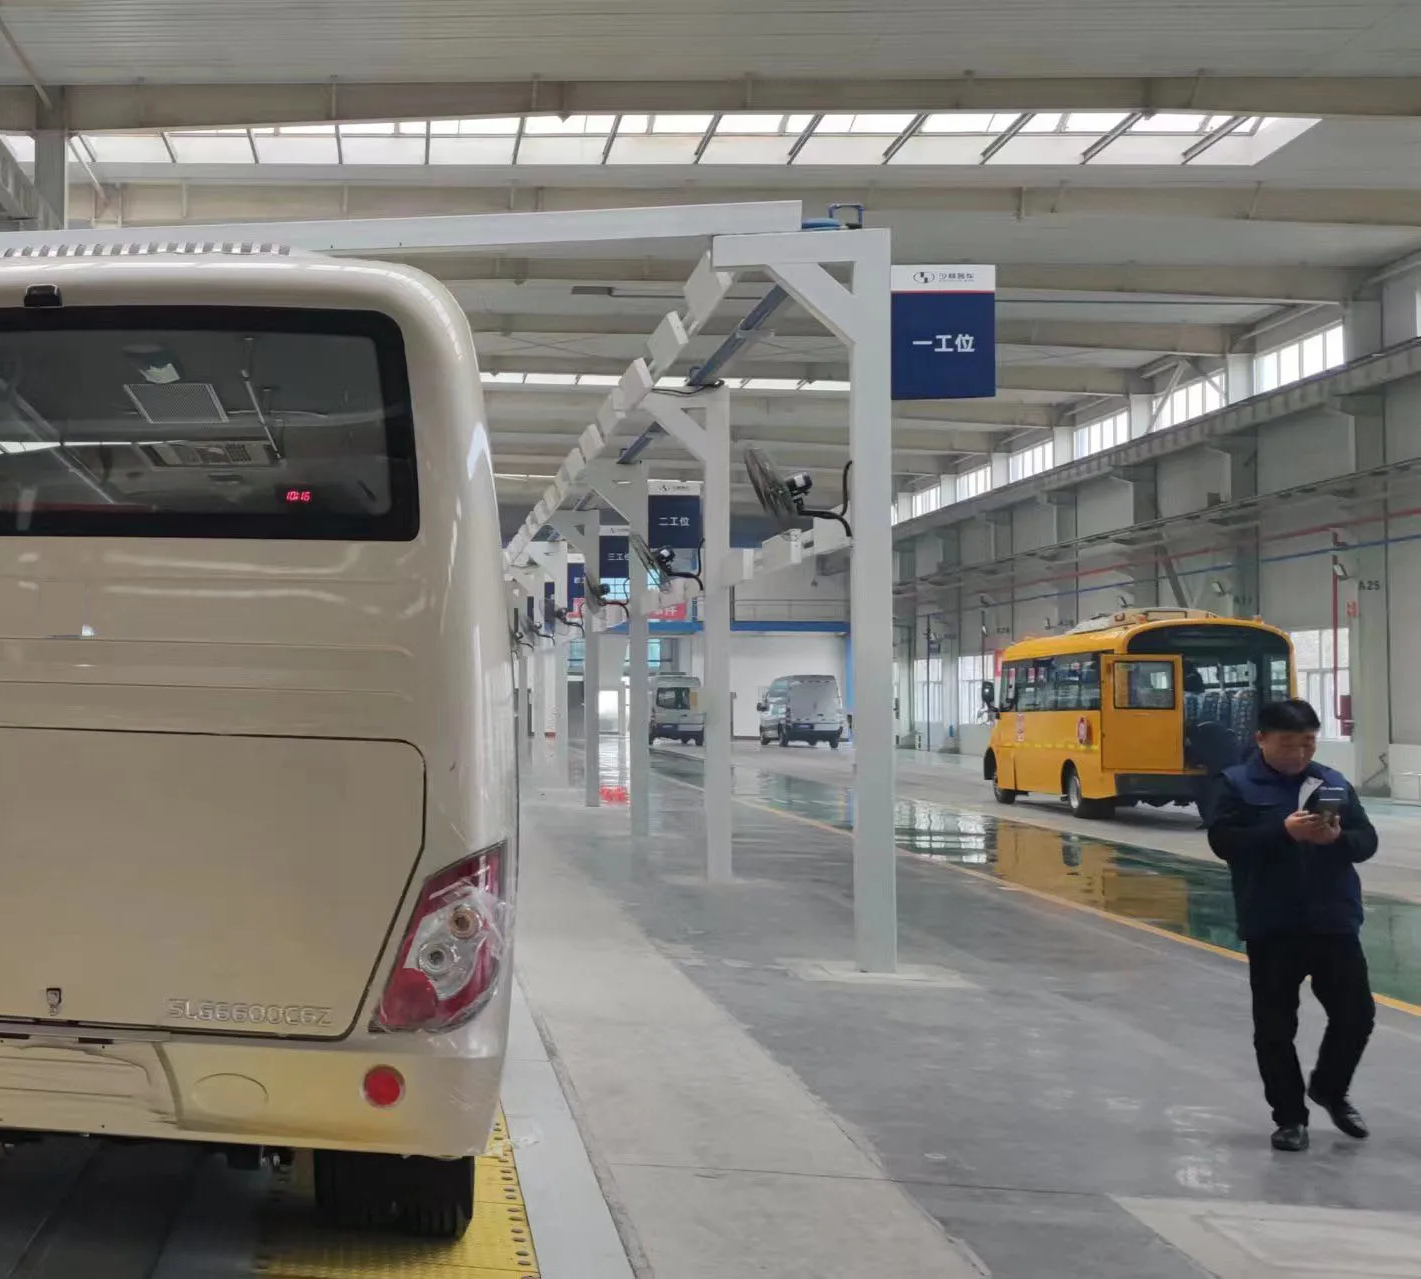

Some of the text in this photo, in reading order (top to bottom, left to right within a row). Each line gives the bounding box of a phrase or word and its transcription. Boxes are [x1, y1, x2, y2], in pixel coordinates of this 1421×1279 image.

[912, 334, 976, 352] 一工位
[658, 516, 691, 527] 二工位
